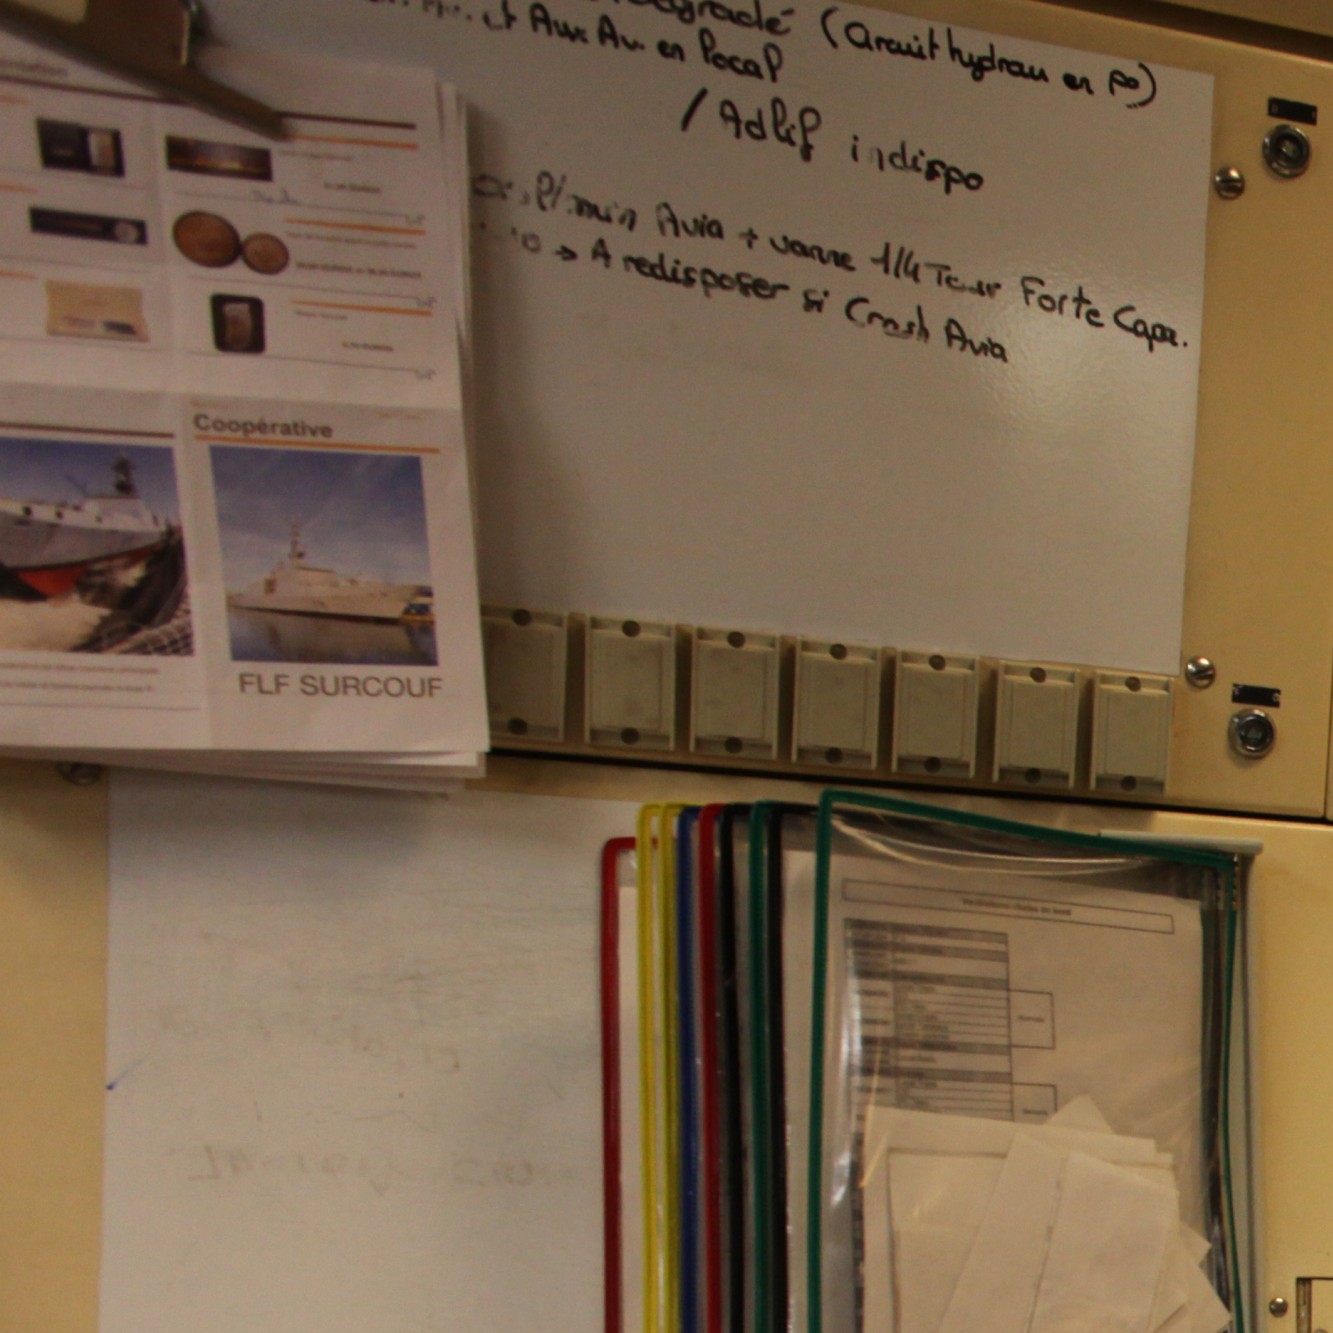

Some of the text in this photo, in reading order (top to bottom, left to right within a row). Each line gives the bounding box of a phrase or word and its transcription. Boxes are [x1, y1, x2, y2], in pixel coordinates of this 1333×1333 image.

[1021, 276, 1105, 329] Forte
[193, 413, 334, 440] Coopérative
[238, 673, 444, 699] FLF SURCOUF
